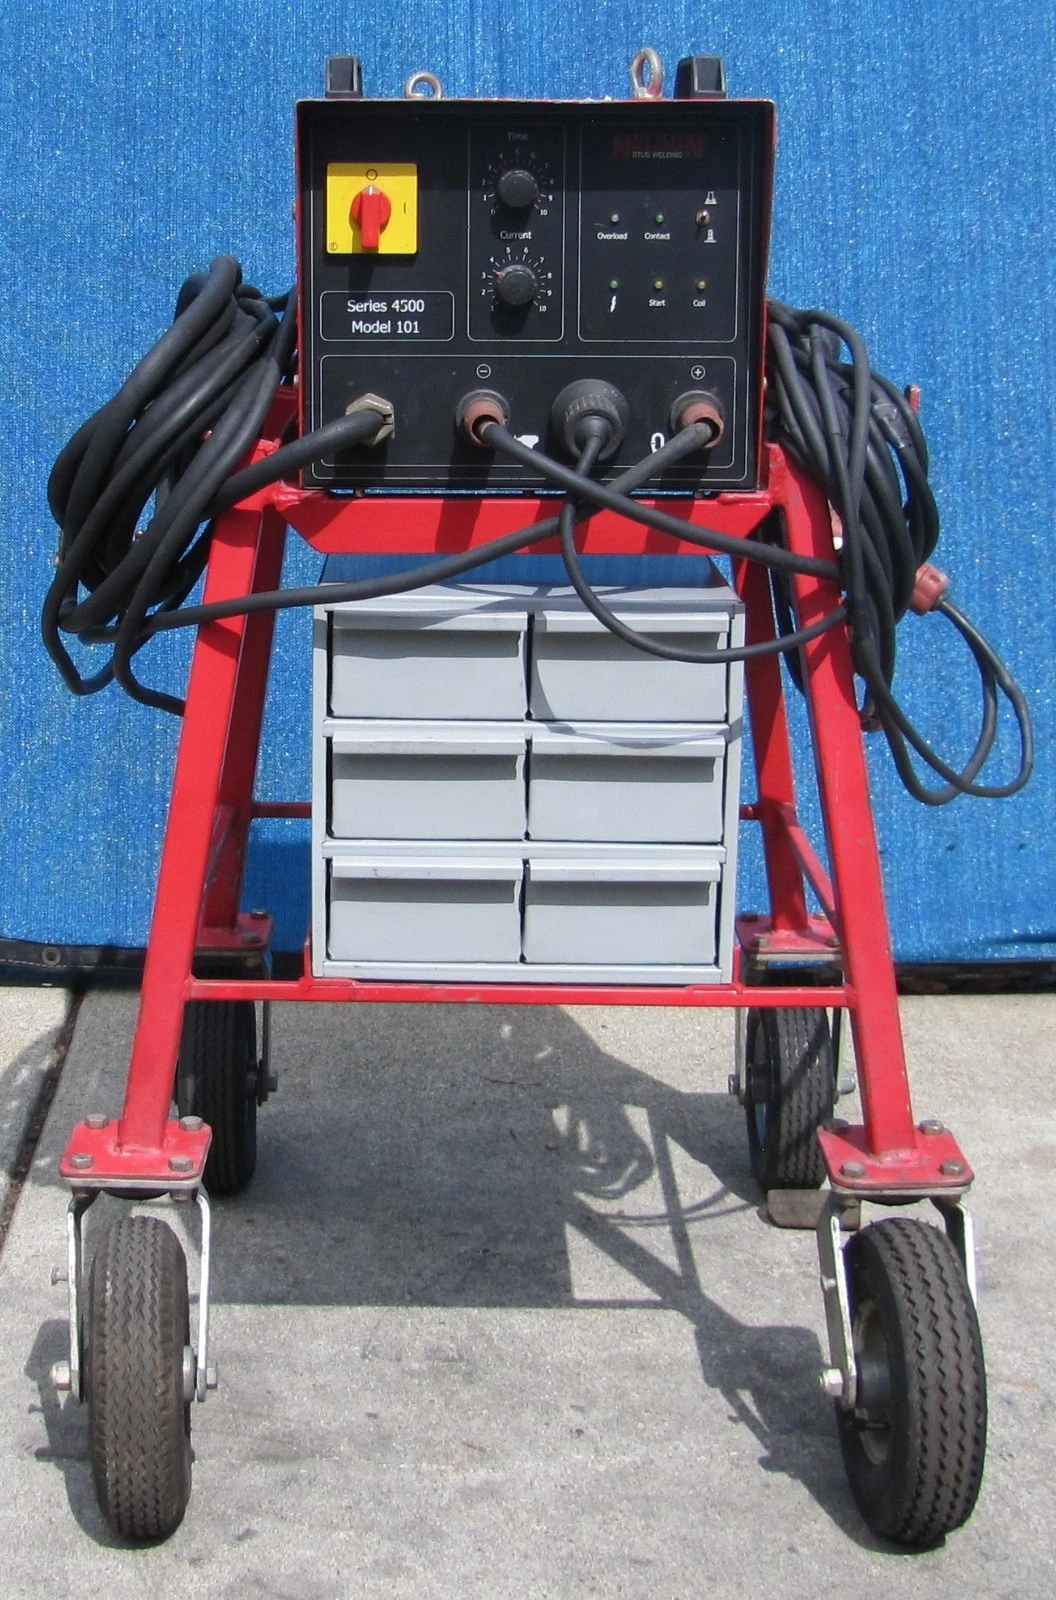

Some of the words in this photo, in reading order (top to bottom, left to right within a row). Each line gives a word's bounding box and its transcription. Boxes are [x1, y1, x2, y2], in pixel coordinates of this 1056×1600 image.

[507, 131, 529, 141] Time
[632, 151, 651, 159] STUD
[652, 151, 683, 159] WELDING
[548, 194, 553, 202] 9
[540, 208, 548, 216] 10
[500, 230, 532, 240] Current
[597, 231, 628, 241] Overload
[643, 231, 671, 241] Contact
[346, 299, 388, 313] Series
[391, 299, 425, 313] 4500
[648, 298, 666, 307] Start
[692, 299, 706, 307] Coil
[539, 305, 547, 313] 10
[351, 320, 391, 334] Model
[396, 321, 420, 334] 101
